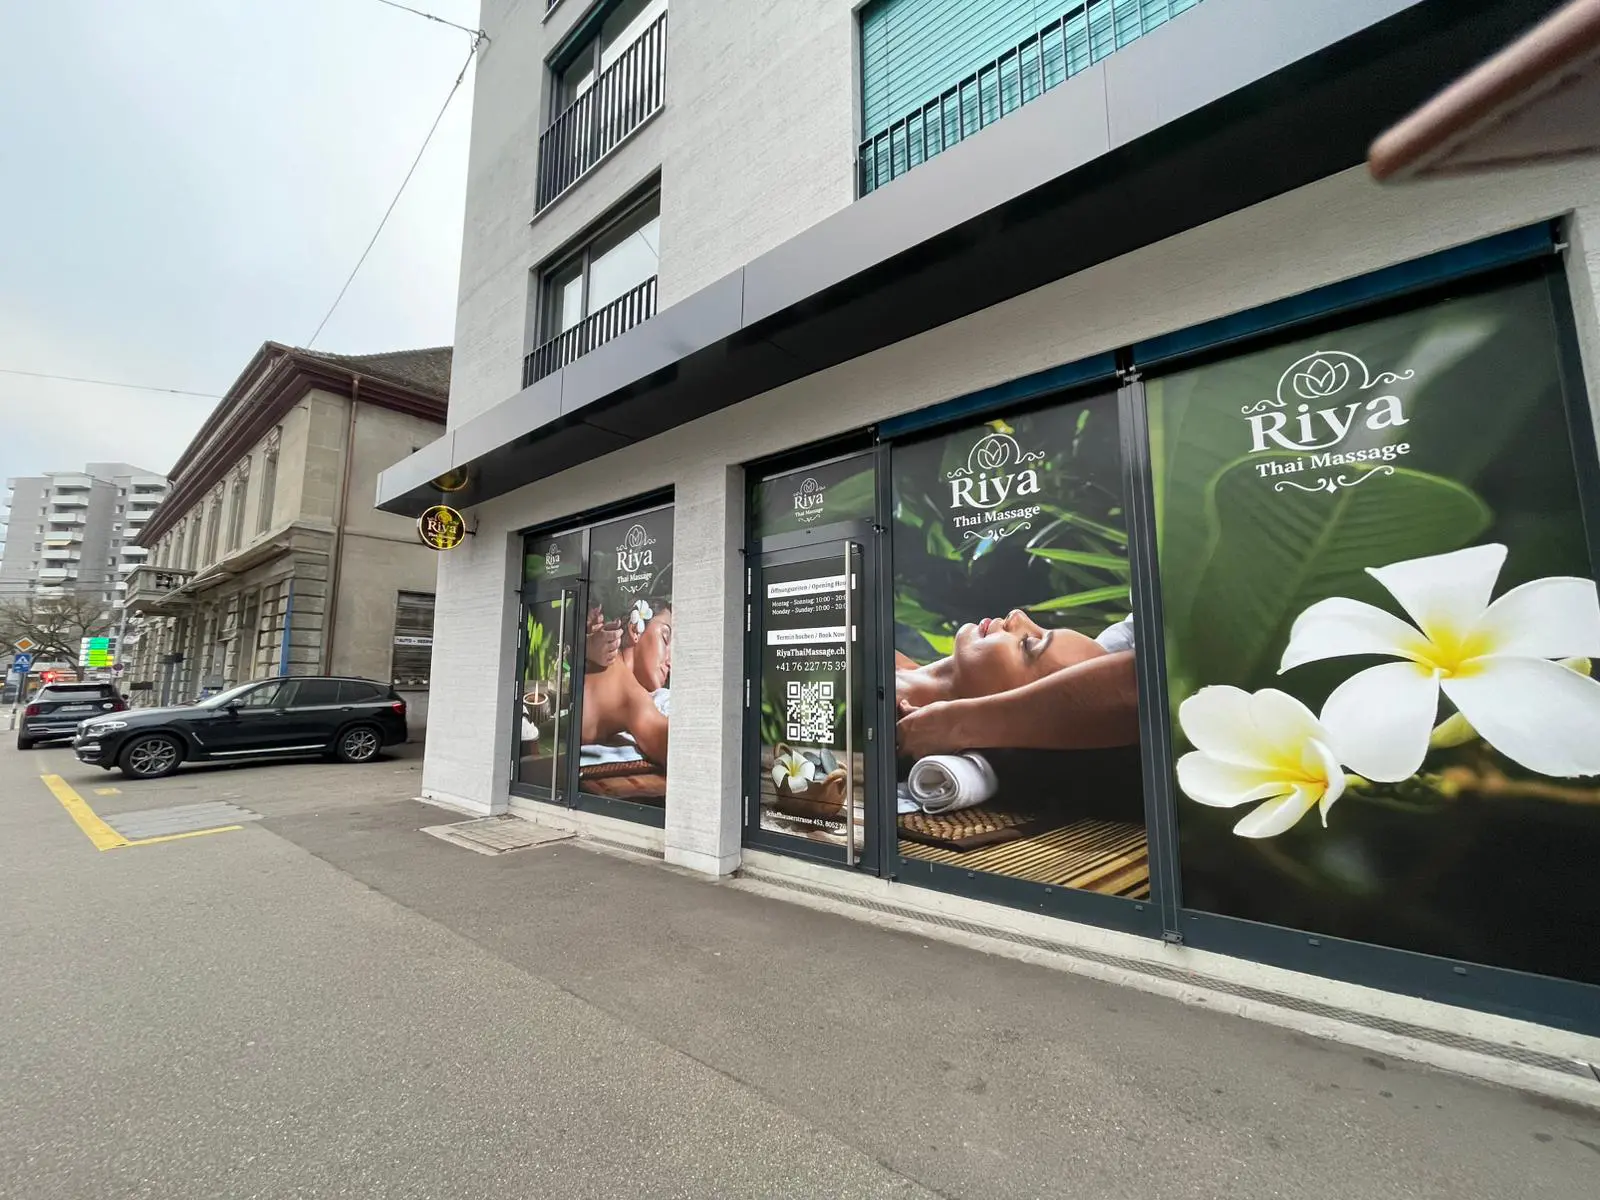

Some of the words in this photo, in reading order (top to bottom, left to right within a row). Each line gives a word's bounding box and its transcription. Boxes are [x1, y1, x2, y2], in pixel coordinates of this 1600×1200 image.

[1244, 395, 1410, 453] Riya
[1255, 457, 1304, 478] Thai
[1310, 442, 1411, 470] Massage
[949, 469, 1041, 509] Riya
[794, 493, 824, 509] Riya
[953, 513, 981, 528] Thai
[984, 505, 1041, 523] Massage
[427, 520, 457, 534] Riya
[616, 549, 653, 573] Riya
[617, 575, 629, 584] Thai
[630, 572, 653, 581] Massage
[811, 580, 835, 591] Opening
[771, 599, 789, 608] Montag
[815, 594, 831, 603] 10:00
[835, 593, 846, 602] 20:0
[771, 607, 790, 616] Monday
[815, 603, 831, 612] 10:00
[835, 602, 846, 611] 20:0
[776, 633, 795, 641] Termin
[818, 631, 832, 639] Book
[776, 646, 846, 659] RiyaThaiMassage.ch
[775, 661, 790, 672] +41
[792, 661, 803, 672] 76
[804, 661, 821, 672] 227
[822, 661, 833, 671] 75
[835, 660, 847, 671] 39
